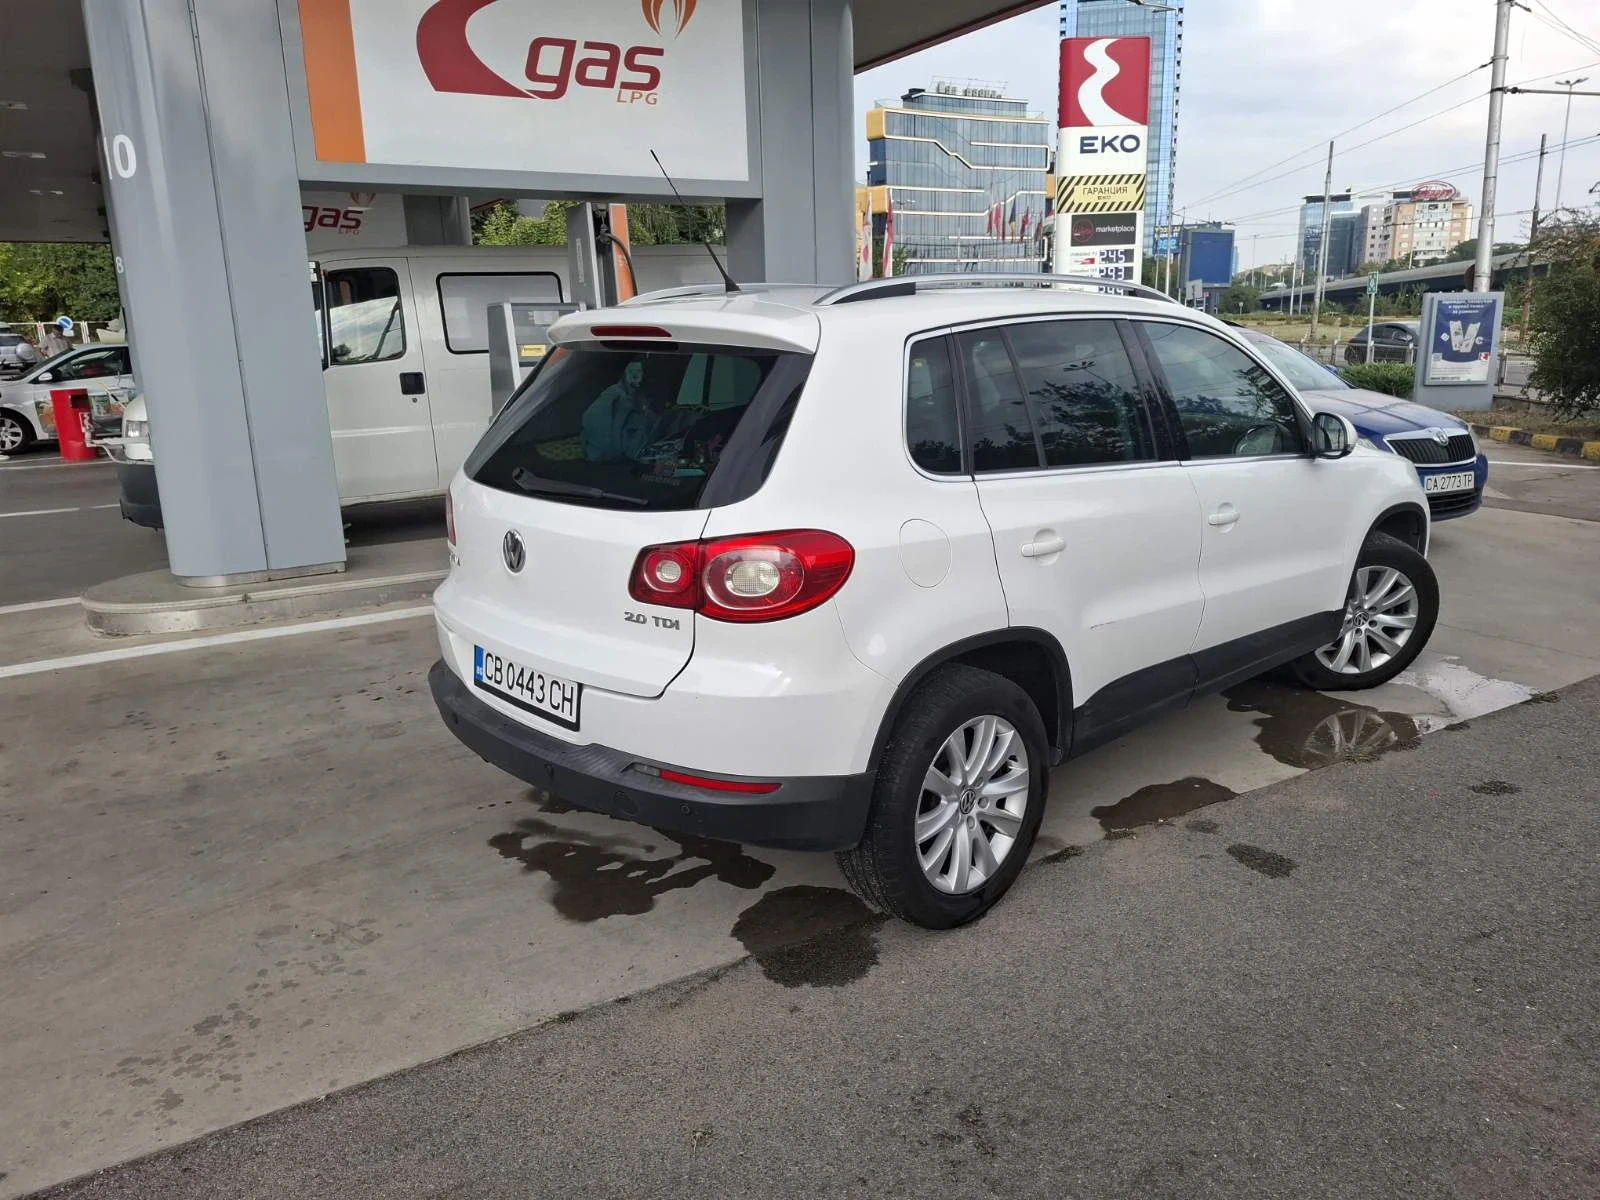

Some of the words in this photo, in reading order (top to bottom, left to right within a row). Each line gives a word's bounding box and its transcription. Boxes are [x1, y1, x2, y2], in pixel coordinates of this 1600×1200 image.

[525, 36, 665, 100] gas
[616, 90, 658, 105] LPG
[1079, 134, 1141, 154] EKO
[1082, 186, 1128, 196] ГАРАНЦИЯ
[1095, 225, 1135, 234] marketplace
[115, 256, 125, 274] 8
[1425, 477, 1439, 491] CA
[1440, 475, 1462, 490] 2773
[1463, 473, 1473, 487] TP
[651, 615, 680, 631] TDI
[485, 652, 503, 686] CB
[506, 662, 546, 704] 0443
[549, 679, 574, 718] CH
